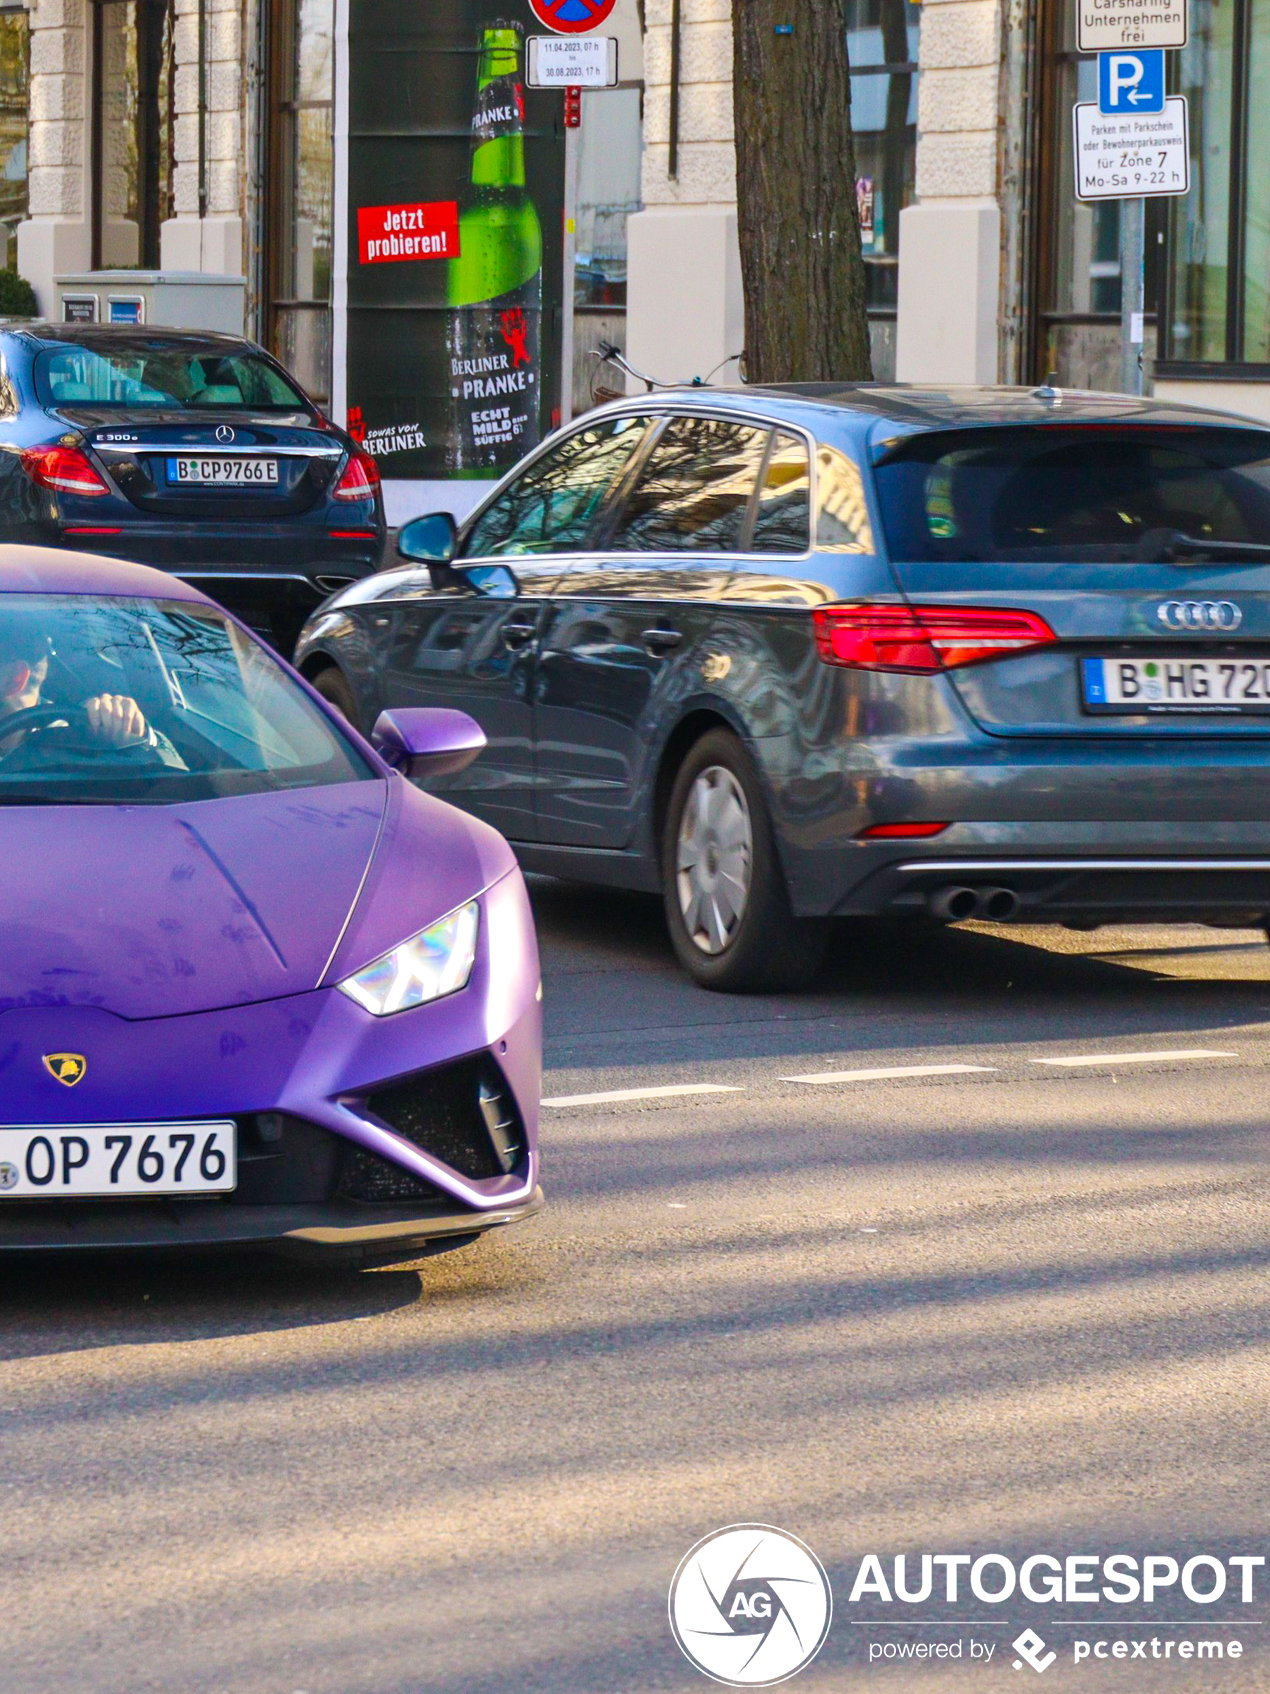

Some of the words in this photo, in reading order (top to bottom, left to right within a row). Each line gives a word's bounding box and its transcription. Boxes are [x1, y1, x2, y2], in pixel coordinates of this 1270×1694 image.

[1085, 12, 1180, 27] Unternehmen
[1121, 30, 1145, 42] frei
[584, 43, 592, 51] 07
[594, 43, 599, 51] h
[586, 67, 594, 76] 17
[595, 67, 600, 75] h
[1110, 55, 1144, 106] P
[472, 106, 512, 130] PRANKE
[1091, 125, 1116, 135] Parken
[1119, 124, 1131, 133] mit
[1134, 121, 1173, 132] Parkschein
[1083, 141, 1099, 151] oder
[1103, 136, 1183, 150] Bewohnerparkausweis
[1097, 159, 1114, 169] für
[1119, 154, 1152, 167] Zone
[1158, 151, 1168, 168] 7
[1085, 174, 1128, 188] Mo-Sa
[1172, 171, 1180, 182] h
[384, 209, 424, 231] Jetzt
[367, 231, 447, 260] probieren!
[451, 354, 509, 376] BERLINER
[463, 371, 526, 399] PRANKE
[471, 407, 510, 422] ECHT
[368, 427, 395, 439] SOWAS
[398, 423, 419, 434] VON
[473, 419, 512, 435] MILD
[362, 432, 427, 455] BERLINER
[474, 432, 513, 446] SÜFFIG
[179, 462, 188, 479] B
[1120, 664, 1140, 698] B
[1165, 664, 1210, 698] HG
[25, 1135, 90, 1186] OP
[104, 1133, 226, 1184] 7676
